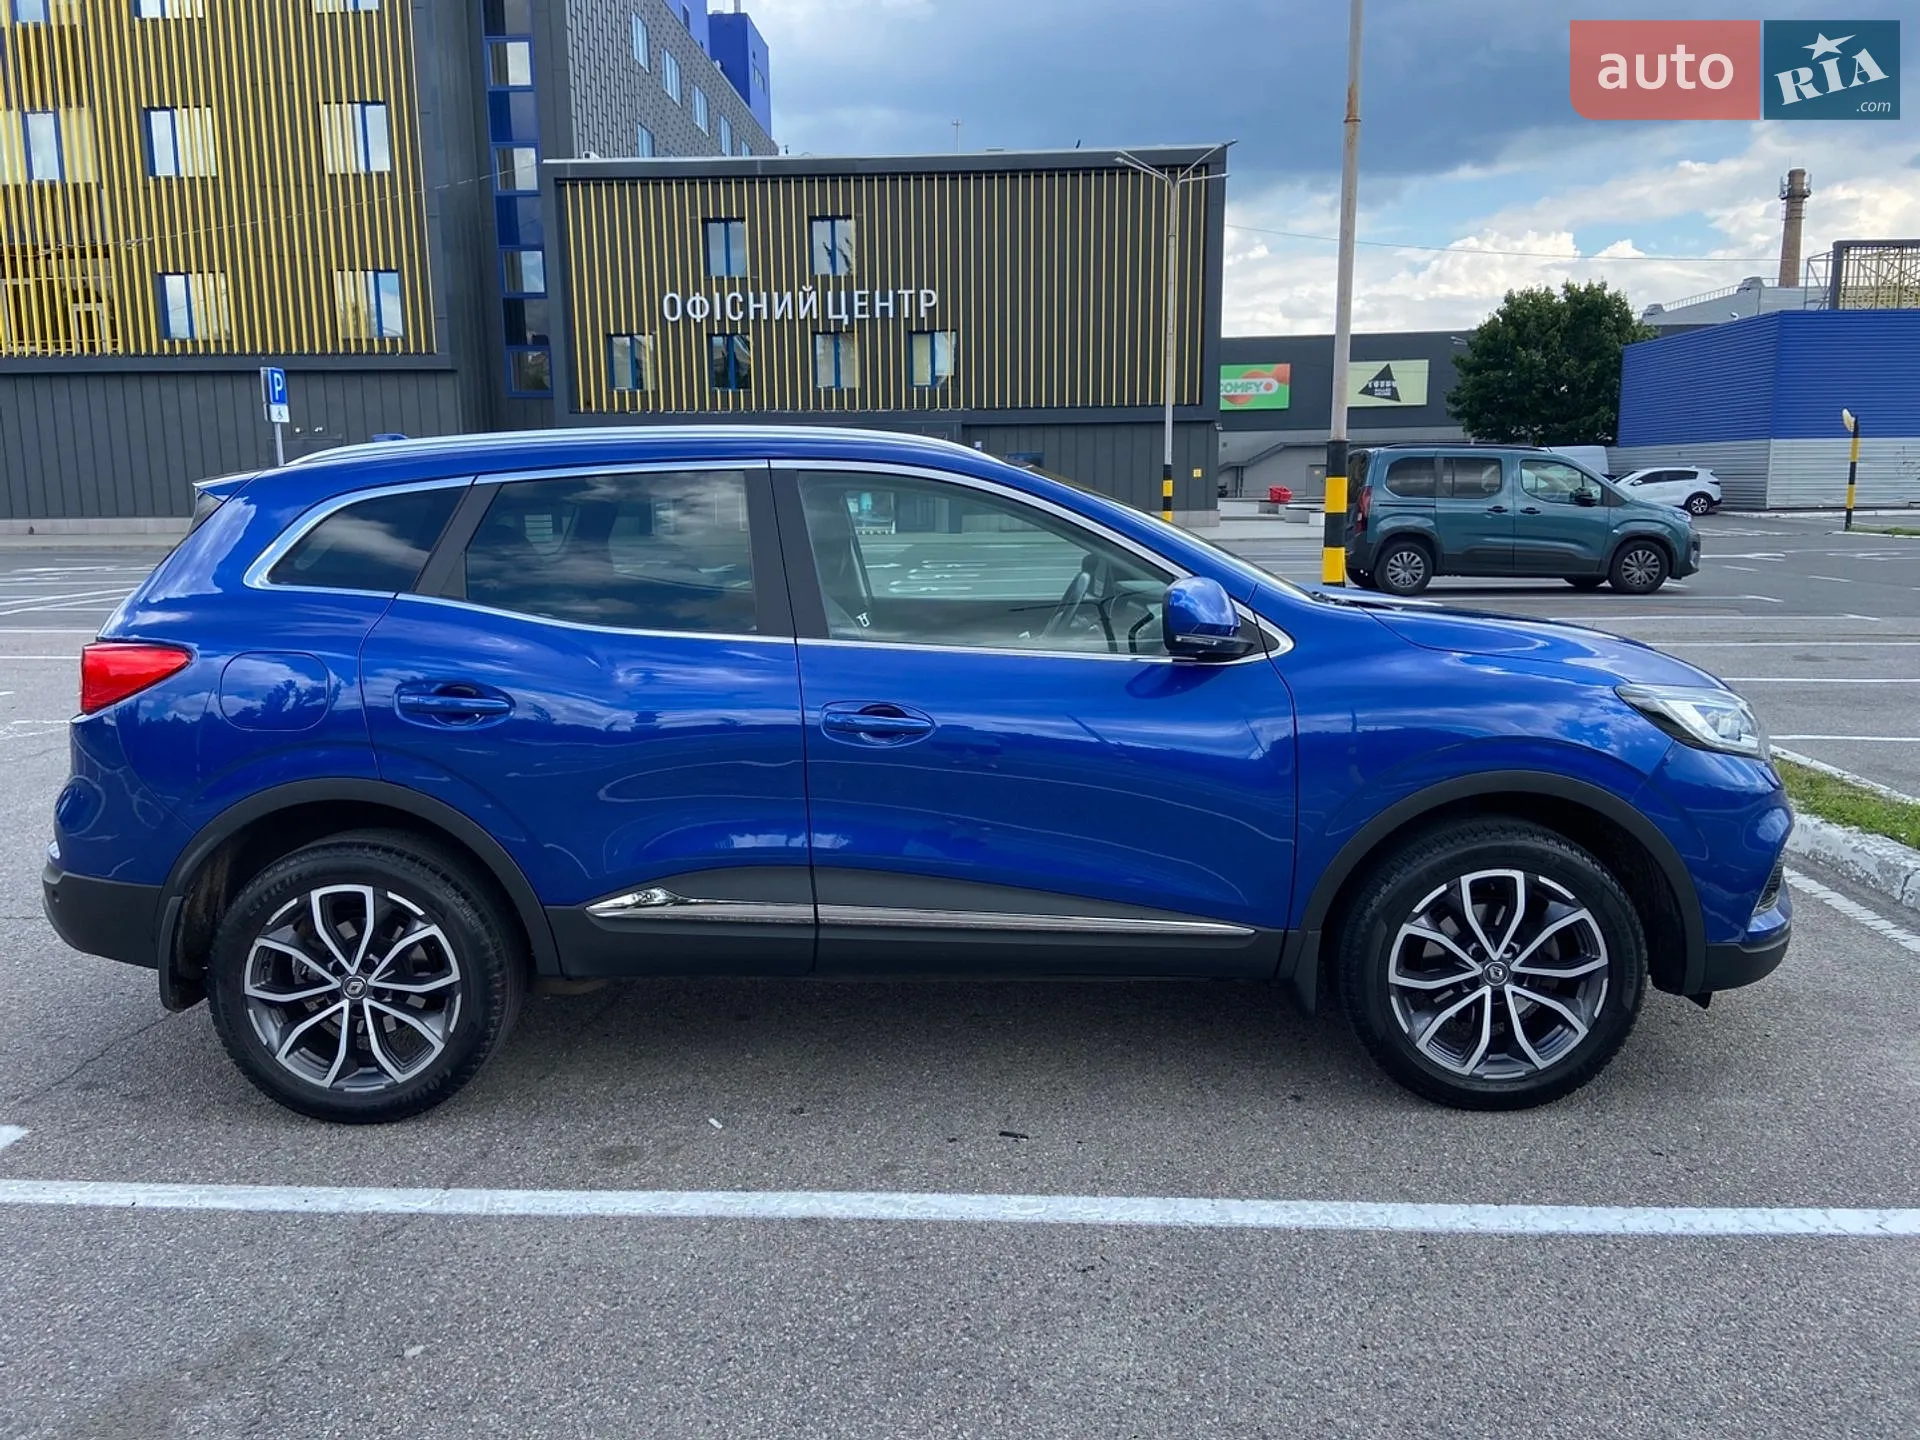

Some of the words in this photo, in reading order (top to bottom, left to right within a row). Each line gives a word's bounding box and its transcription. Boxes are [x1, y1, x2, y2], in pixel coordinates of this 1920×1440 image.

[662, 285, 819, 323] ОФІСНИЙ
[827, 289, 938, 326] ЦЕНТР
[273, 372, 284, 401] P
